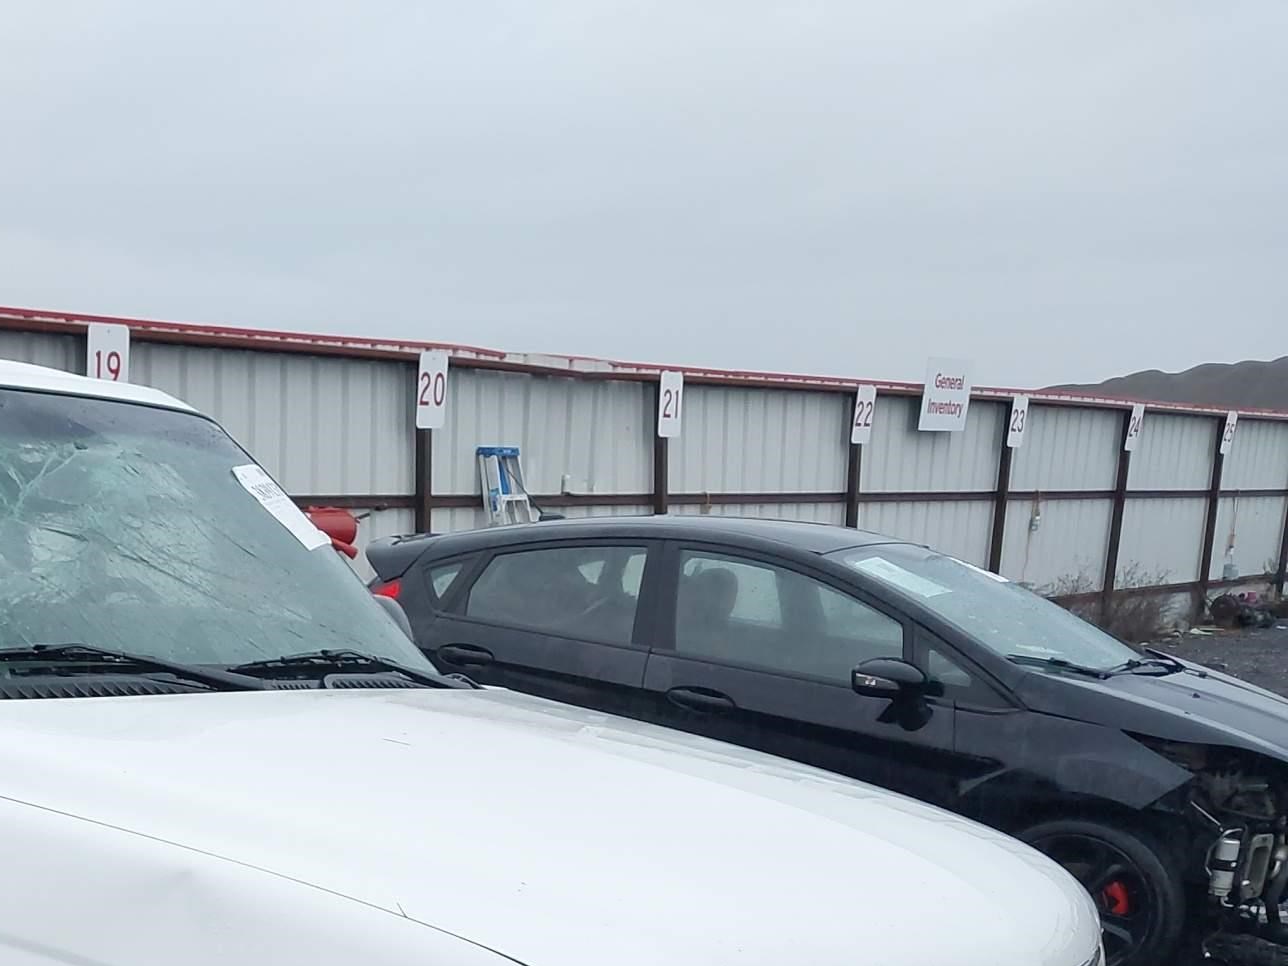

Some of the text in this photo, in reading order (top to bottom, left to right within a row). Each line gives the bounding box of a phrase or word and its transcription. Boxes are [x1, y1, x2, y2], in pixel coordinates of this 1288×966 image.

[95, 350, 121, 381] 19
[419, 371, 445, 407] 20
[935, 372, 965, 390] General
[663, 388, 680, 419] 21
[855, 401, 873, 427] 22
[927, 398, 963, 419] Inventory
[1011, 408, 1025, 433] 23
[1128, 416, 1142, 437] 24
